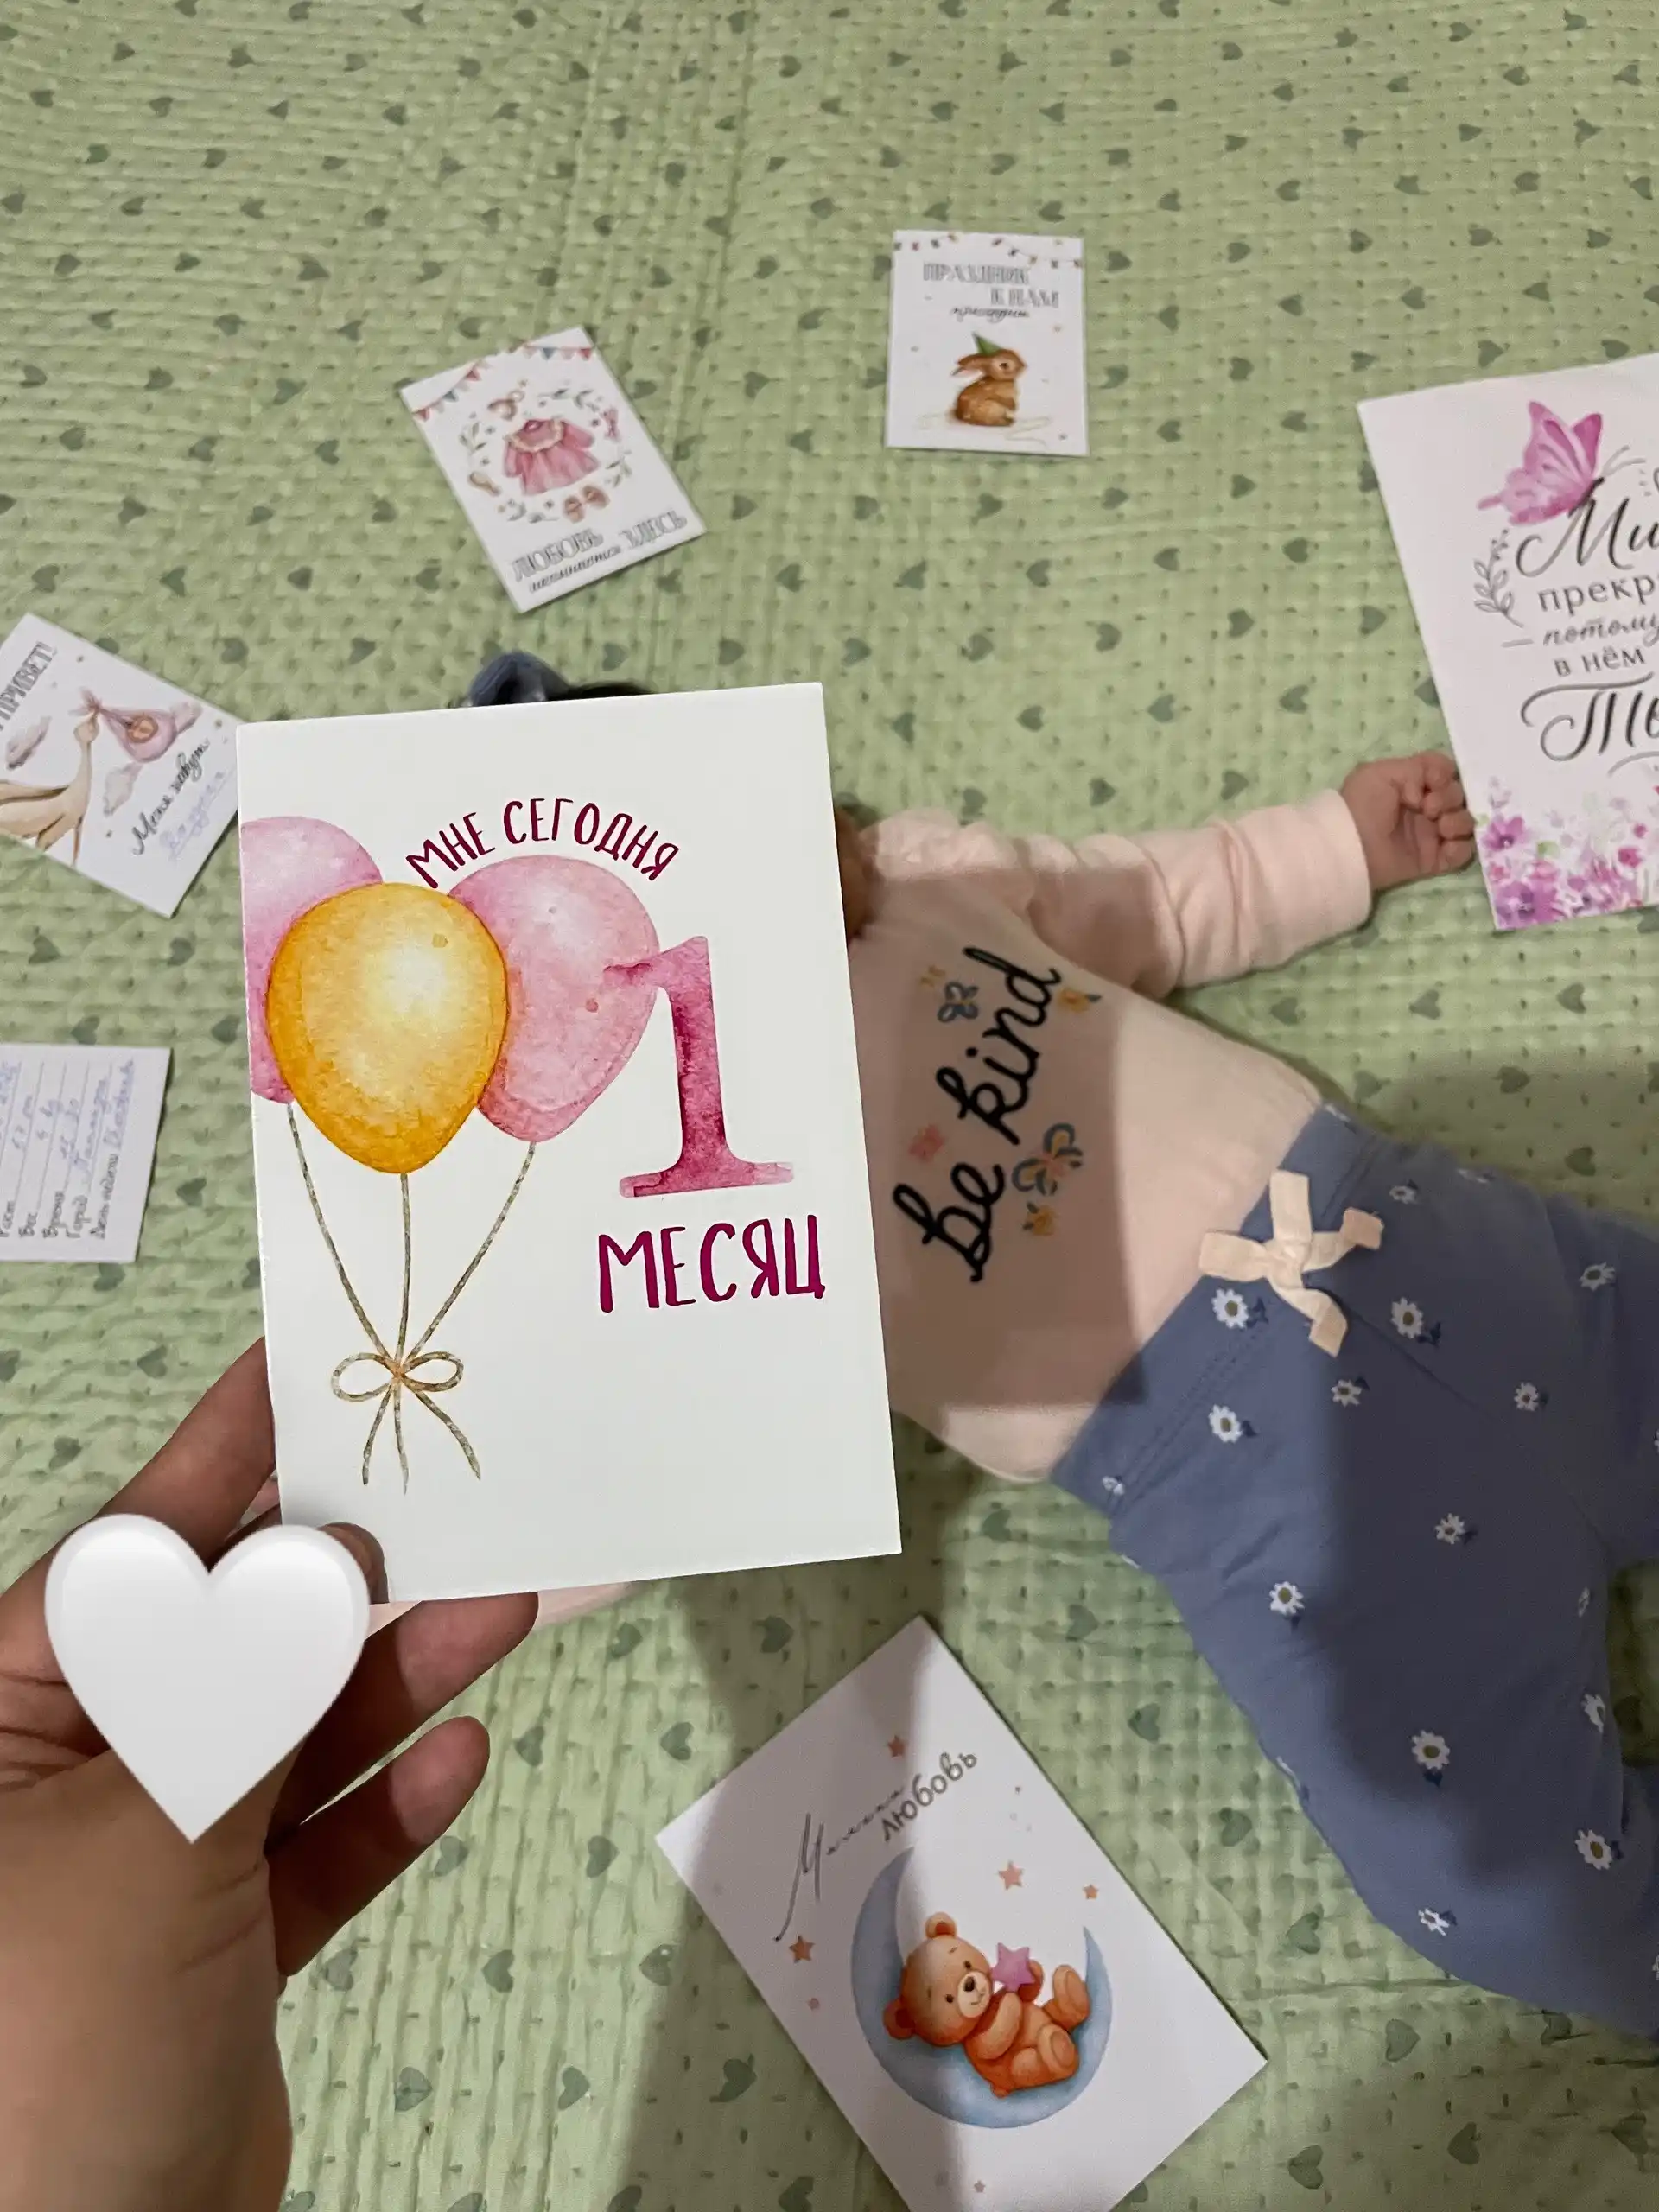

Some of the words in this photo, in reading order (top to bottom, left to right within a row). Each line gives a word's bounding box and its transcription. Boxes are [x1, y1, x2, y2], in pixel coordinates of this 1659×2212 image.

[511, 528, 604, 582] ЛЮБОВЬ
[1537, 574, 1659, 617] прекр
[1554, 658, 1572, 677] в
[1581, 645, 1646, 673] нём
[406, 811, 496, 889] МНЕ
[503, 797, 679, 881] СЕГОДНЯ
[603, 935, 795, 1198] 1
[936, 946, 1062, 1147] kind
[598, 1214, 826, 1313] МЕСЯЦ
[893, 1162, 1005, 1283] be
[880, 1751, 978, 1842] любовь
